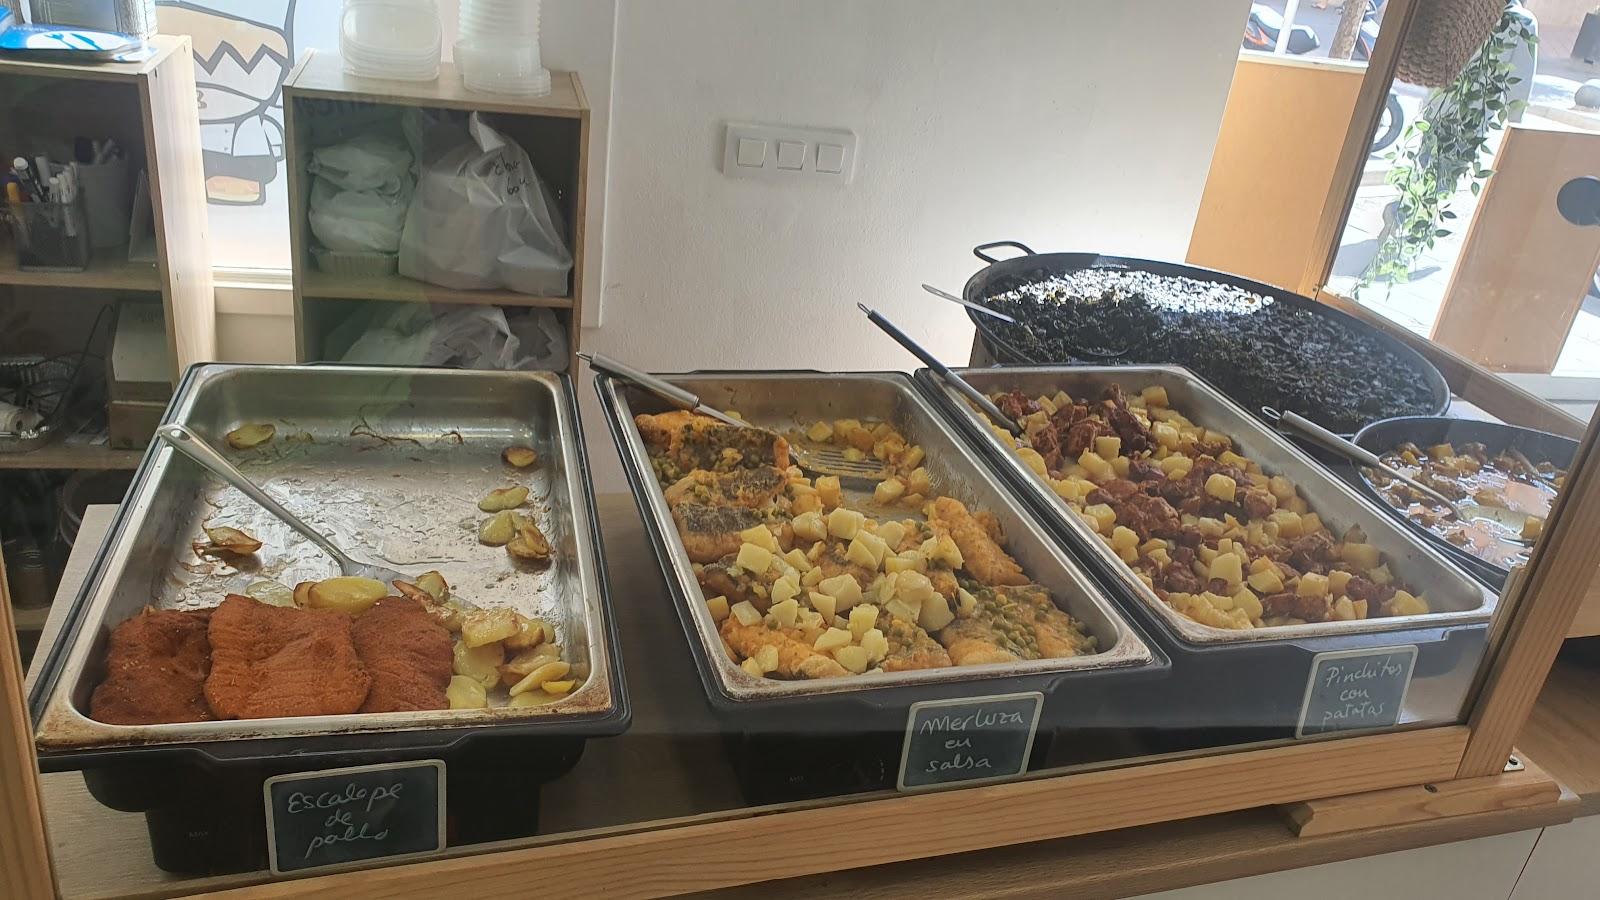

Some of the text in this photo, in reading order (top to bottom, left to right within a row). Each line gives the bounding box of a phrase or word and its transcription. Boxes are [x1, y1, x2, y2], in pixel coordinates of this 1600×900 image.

[1326, 656, 1402, 687] Pinchitos
[920, 708, 1024, 735] Merluza
[1321, 701, 1385, 731] patatas
[925, 753, 992, 773] salsa
[288, 782, 403, 813] Escalope
[325, 808, 353, 827] de
